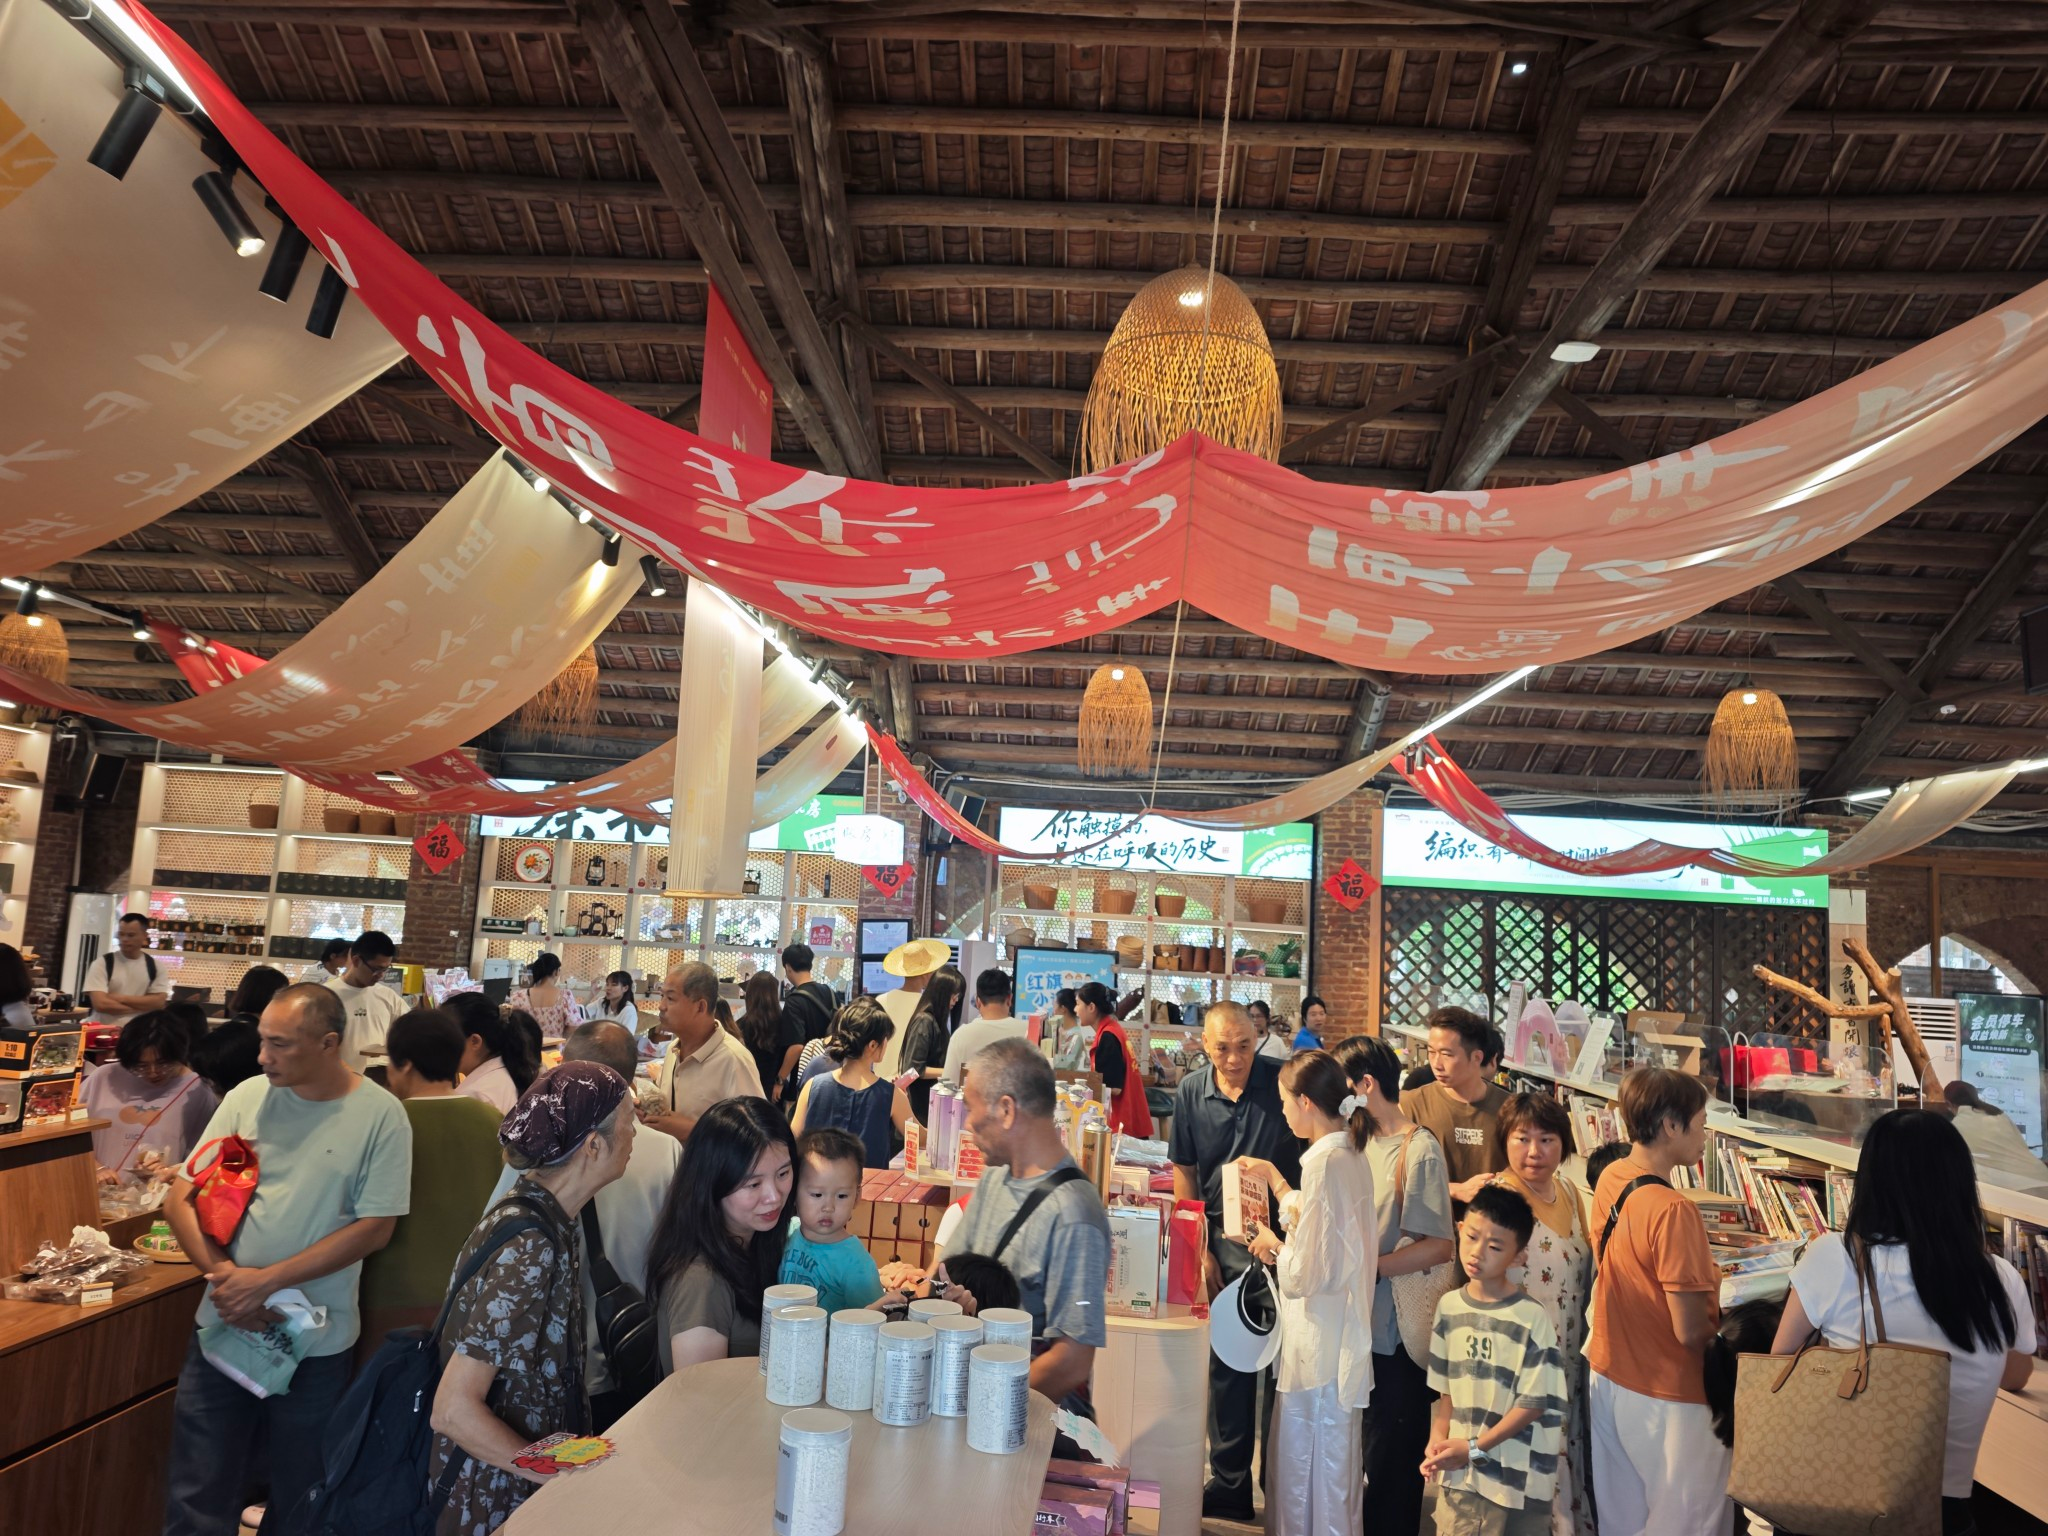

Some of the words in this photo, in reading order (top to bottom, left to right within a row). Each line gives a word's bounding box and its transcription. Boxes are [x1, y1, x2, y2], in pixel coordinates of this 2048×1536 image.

[427, 834, 450, 859] 福
[1338, 873, 1364, 899] 福
[1027, 973, 1063, 990] 红旗
[1971, 1013, 2025, 1030] 会员停车
[1466, 1335, 1492, 1360] 39
